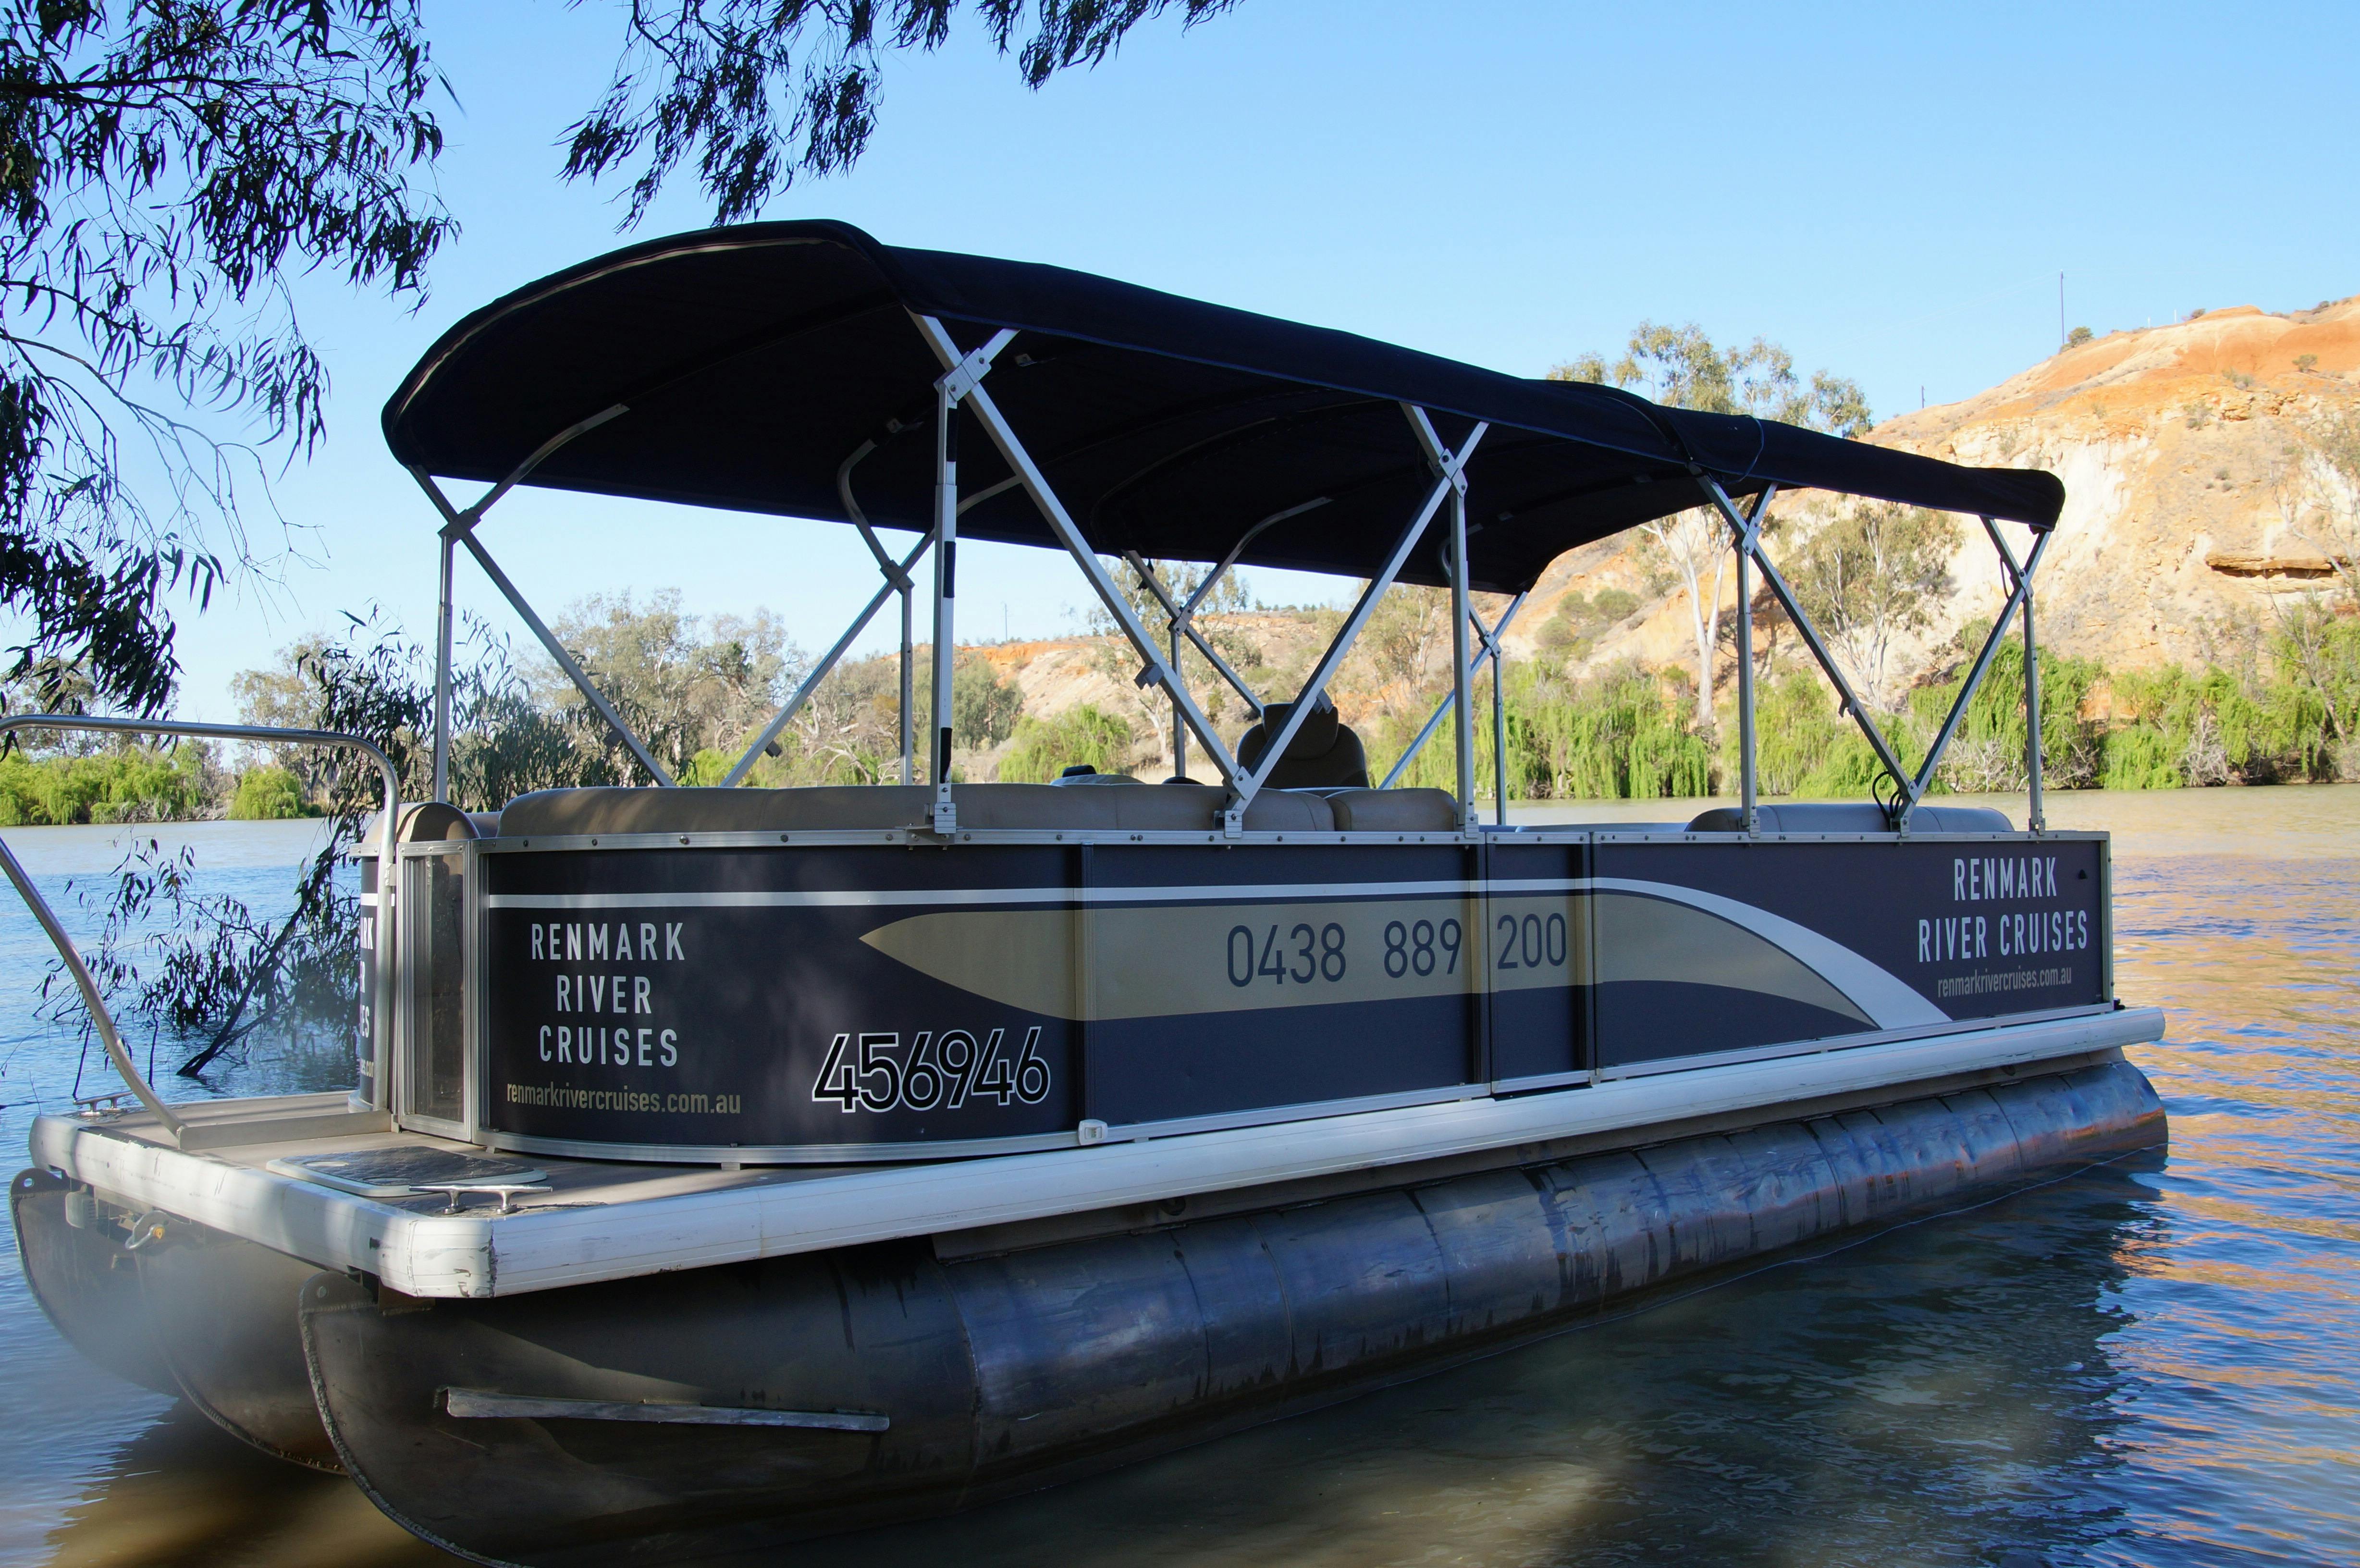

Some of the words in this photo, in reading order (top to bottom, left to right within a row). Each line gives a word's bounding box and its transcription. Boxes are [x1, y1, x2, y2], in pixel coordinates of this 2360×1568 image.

[1954, 857, 2056, 900] RENMARK
[531, 922, 685, 960] RENMARK
[1227, 922, 1346, 987] 0438
[1384, 918, 1462, 978] 889
[1497, 913, 1567, 969] 200
[1919, 916, 1987, 962] RIVER
[2000, 910, 2087, 956] CRUISES
[557, 975, 651, 1014] RIVER
[1938, 965, 2072, 998] renmarkrivercruises.com.au
[540, 1025, 677, 1066] CRUISES
[812, 1026, 1051, 1113] 456946
[507, 1081, 740, 1114] renmarkrivercruises.com.au
